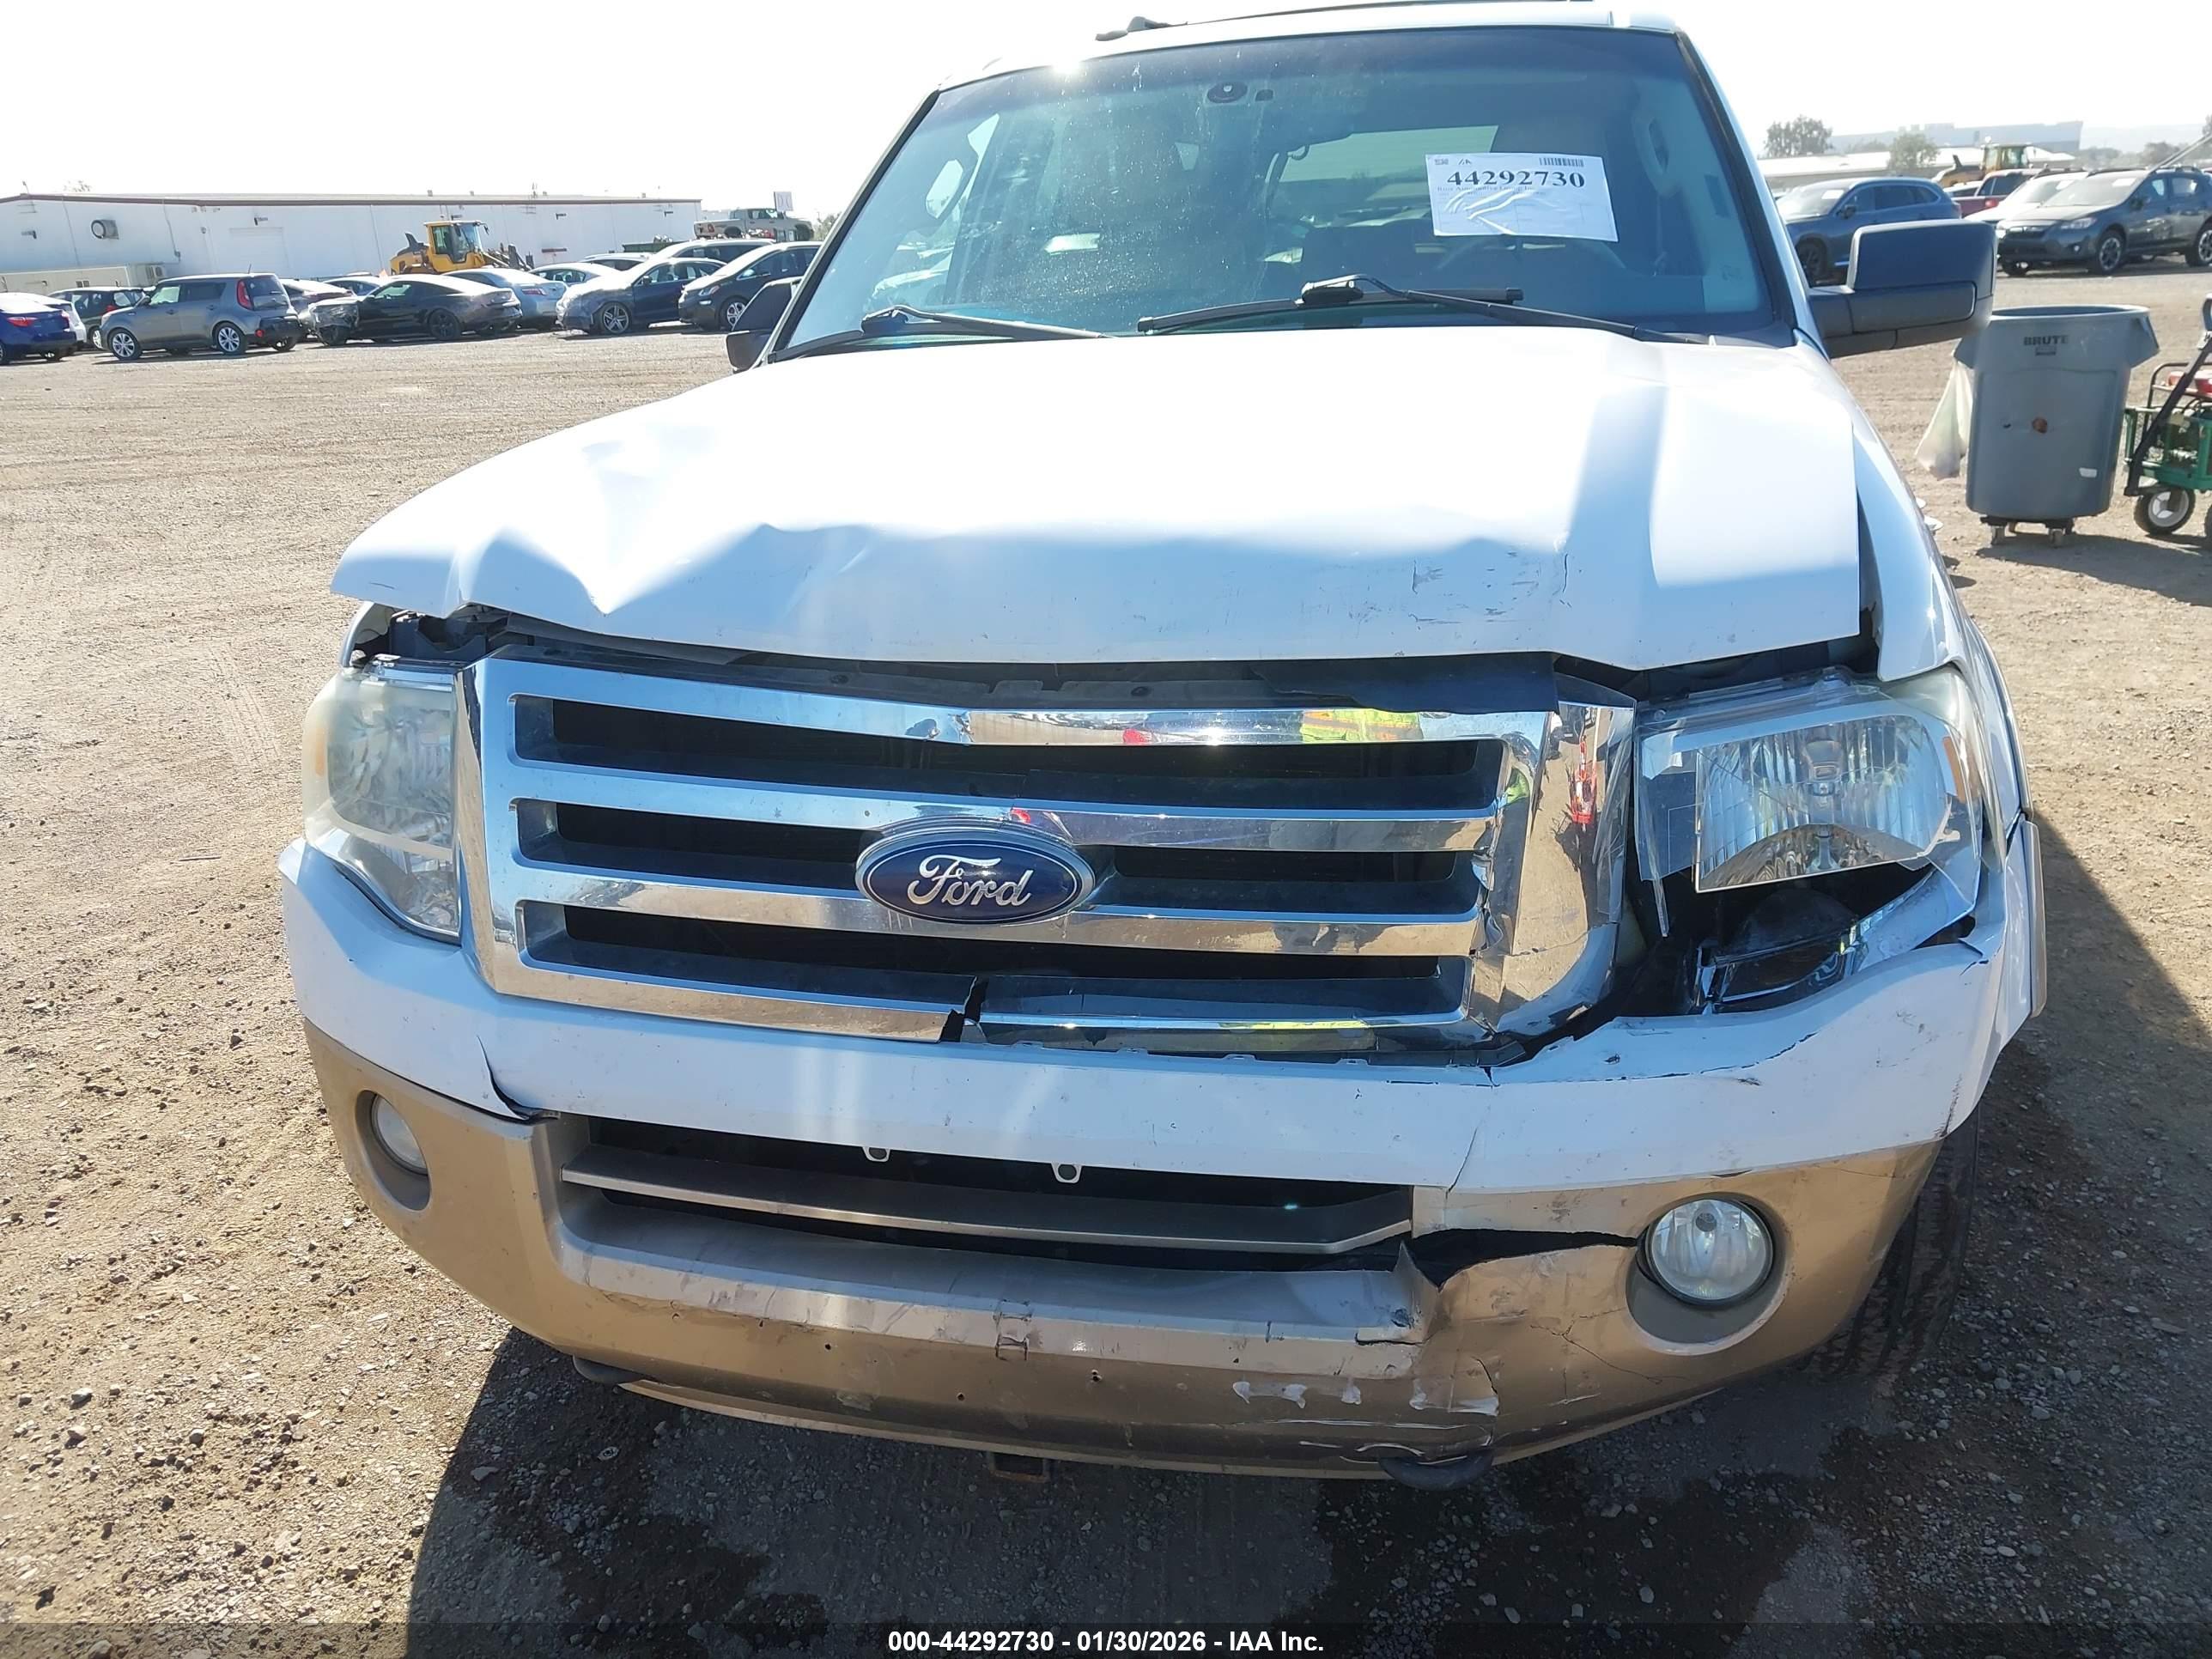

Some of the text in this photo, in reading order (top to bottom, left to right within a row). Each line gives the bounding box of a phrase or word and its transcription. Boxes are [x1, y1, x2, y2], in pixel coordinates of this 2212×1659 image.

[1447, 171, 1585, 187] 44292730
[2023, 335, 2069, 345] BRUTE
[907, 854, 1033, 907] Ford
